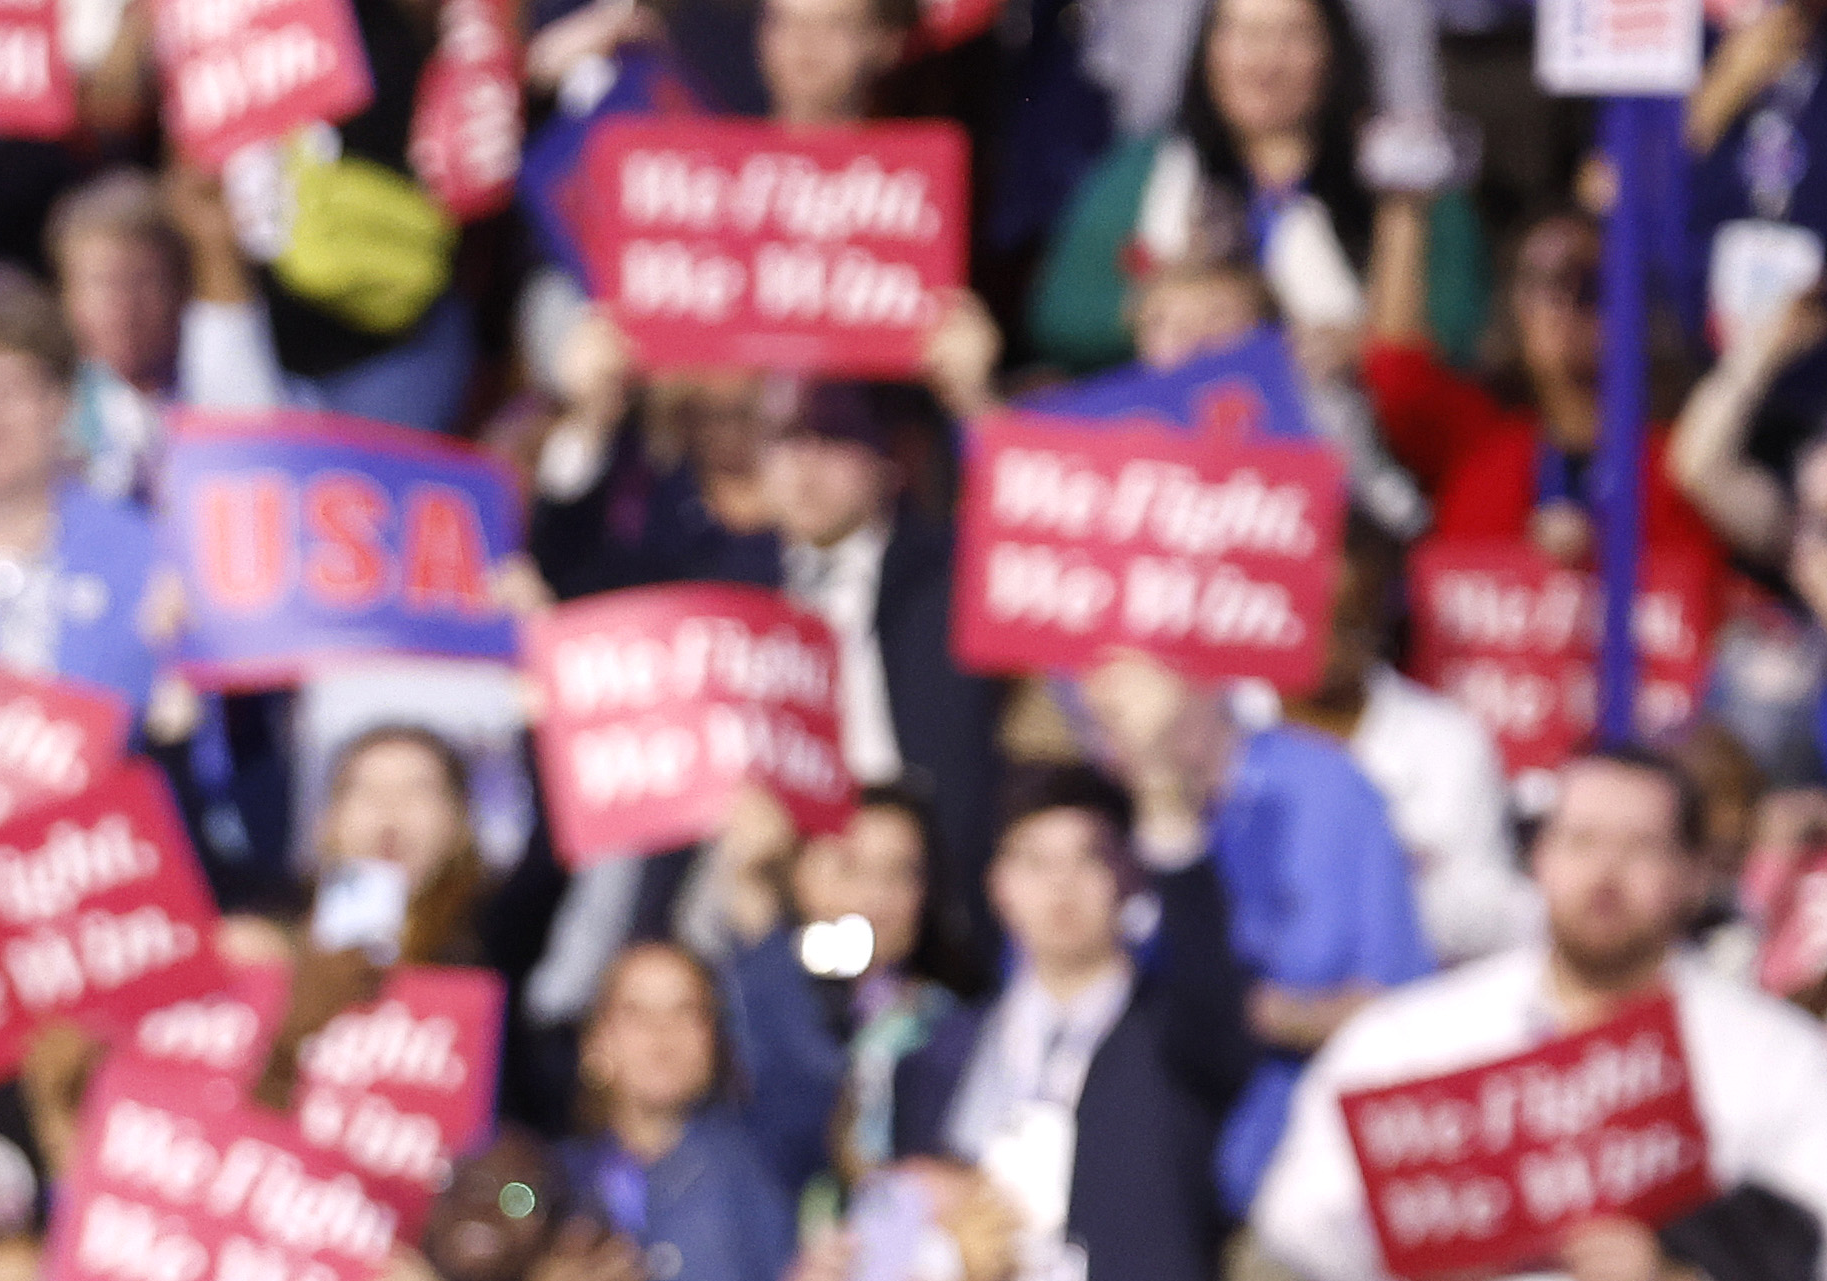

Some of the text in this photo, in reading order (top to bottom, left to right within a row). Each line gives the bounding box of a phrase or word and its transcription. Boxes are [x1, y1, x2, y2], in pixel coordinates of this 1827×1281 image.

[620, 151, 942, 239] We Fight.
[620, 239, 952, 327] We Win.
[199, 463, 493, 620] USA
[992, 447, 1319, 560] We Fight.
[987, 541, 1307, 647] We Win.
[552, 638, 671, 710] We
[569, 724, 703, 808] We
[0, 906, 201, 1014] Win.
[96, 1096, 219, 1200] We
[1356, 1028, 1688, 1169] We Fight.
[1377, 1122, 1703, 1250] We Win.
